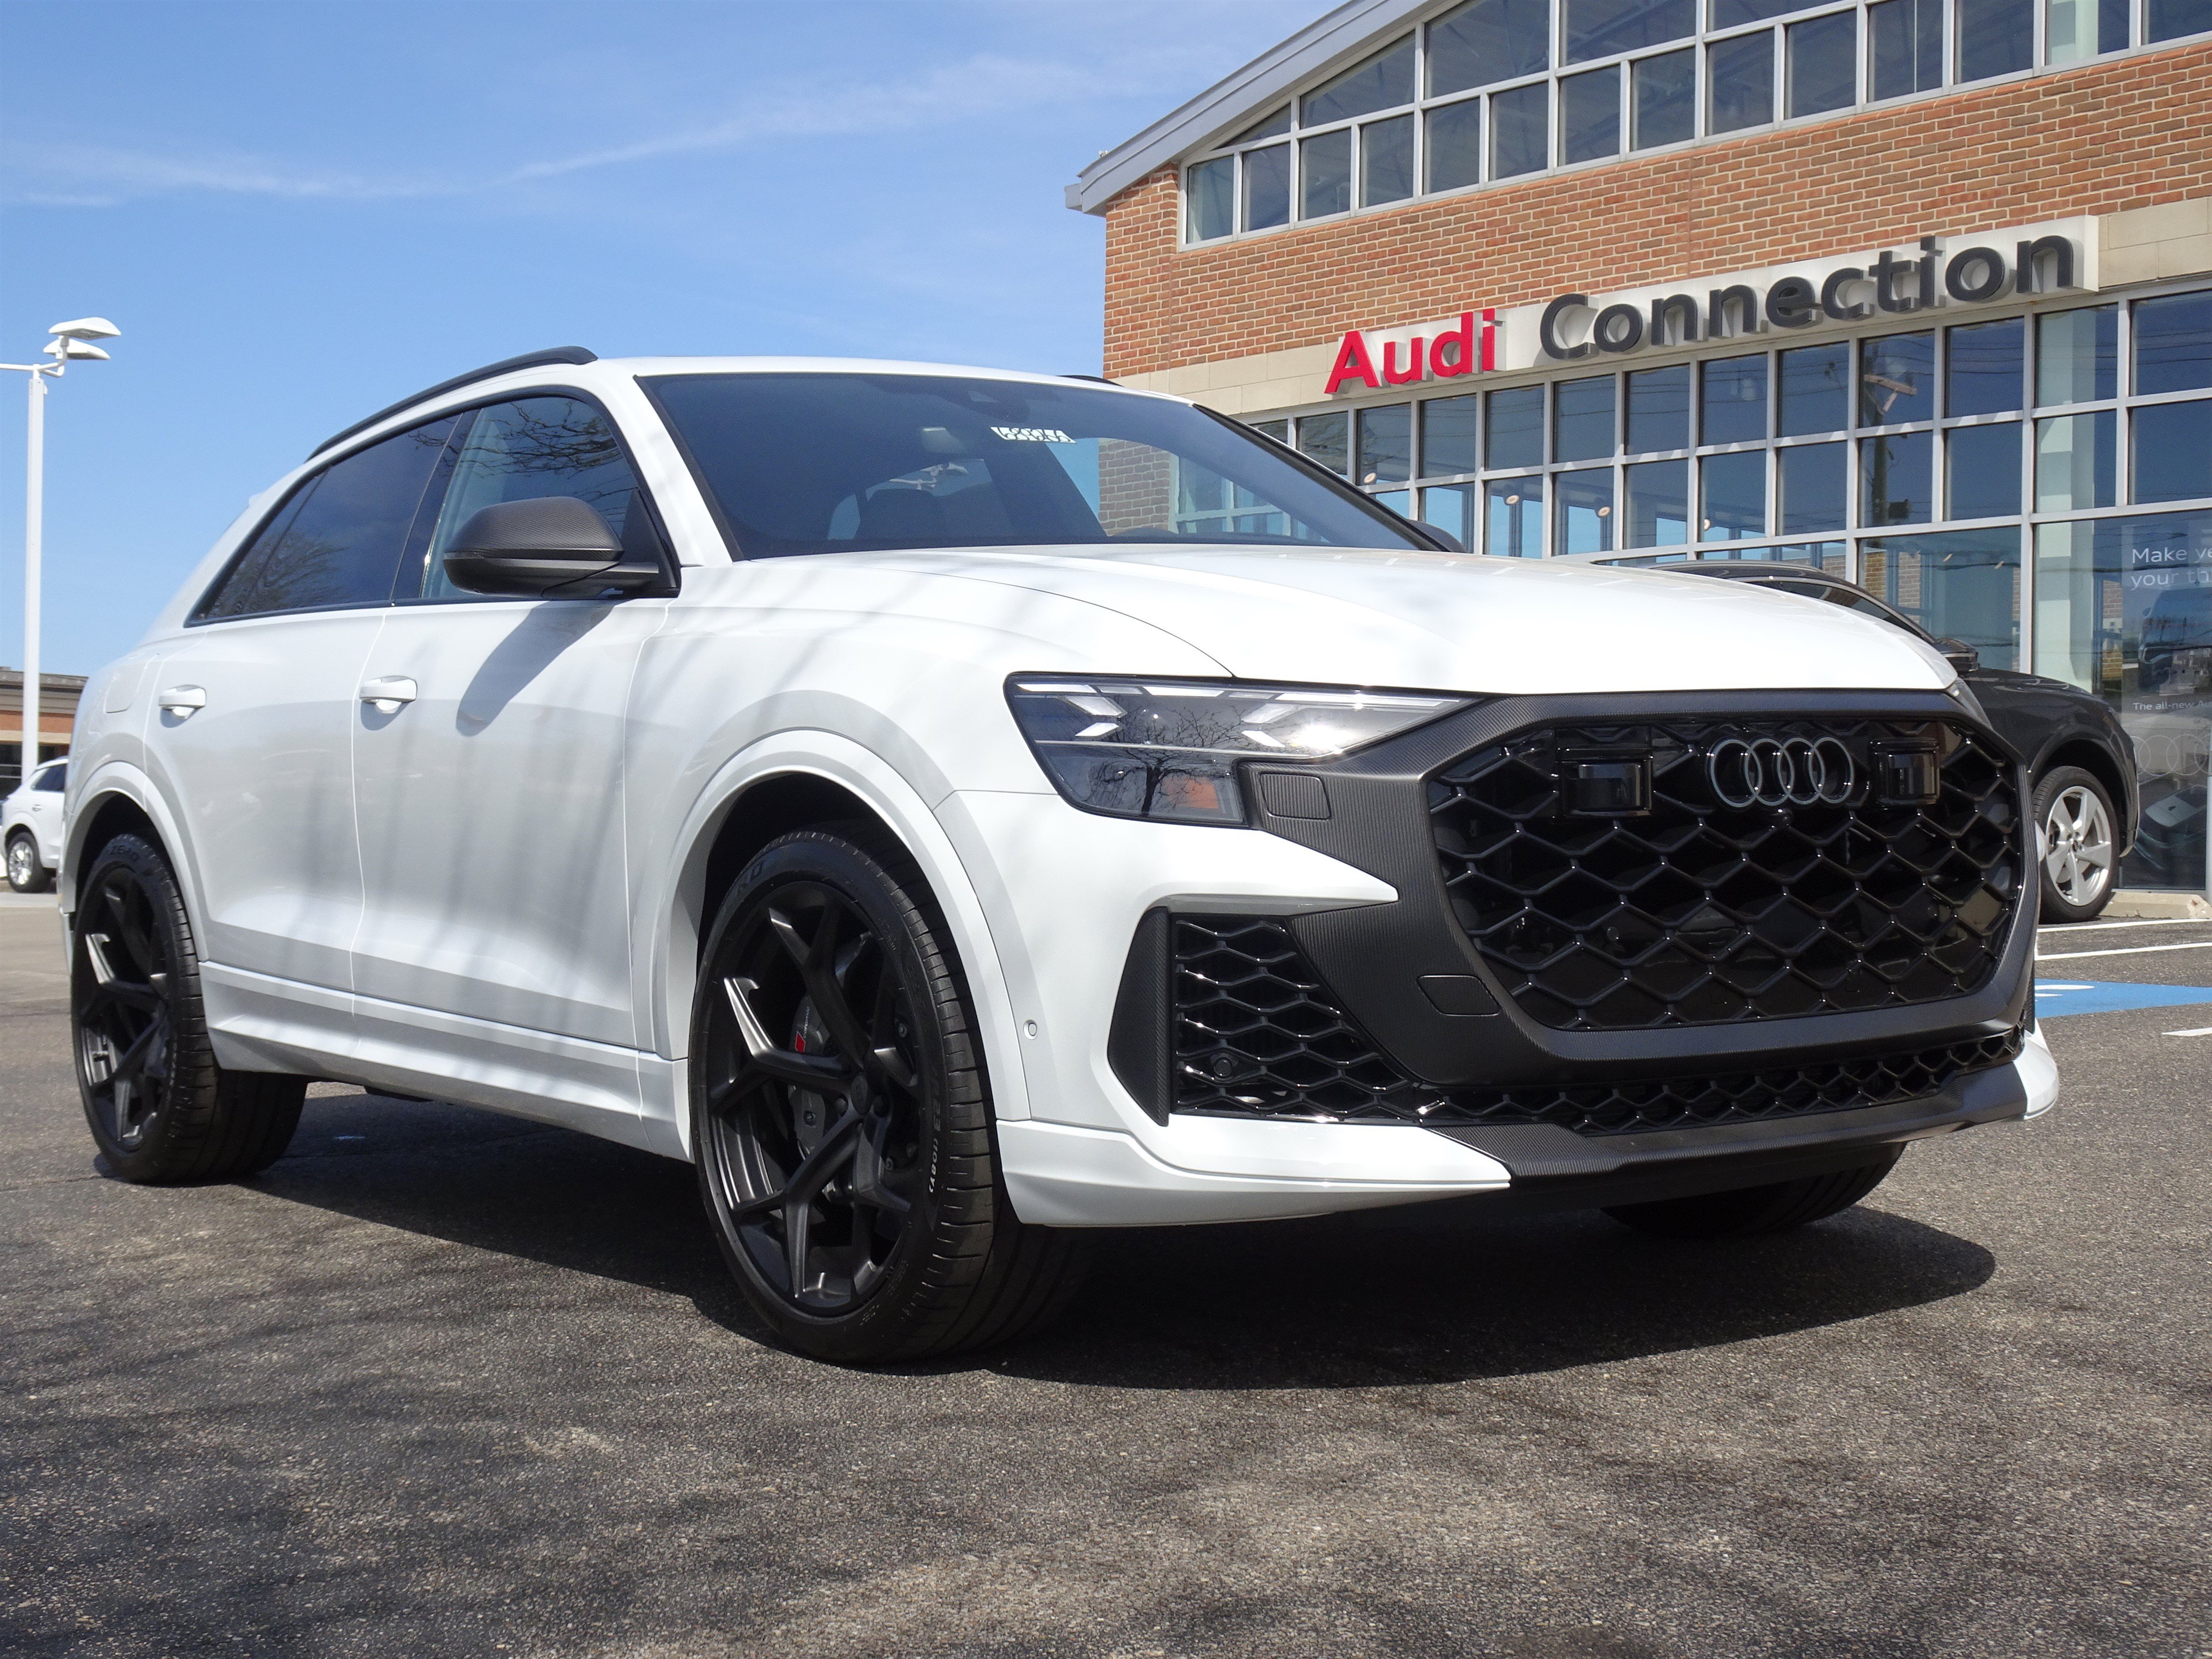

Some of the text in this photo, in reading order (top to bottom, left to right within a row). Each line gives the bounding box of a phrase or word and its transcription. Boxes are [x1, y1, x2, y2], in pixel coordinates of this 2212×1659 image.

[1324, 235, 2075, 394] Audi Connection
[2132, 547, 2187, 564] Make
[2130, 567, 2212, 591] your th
[2133, 702, 2153, 711] The
[2155, 701, 2194, 710] all-new
